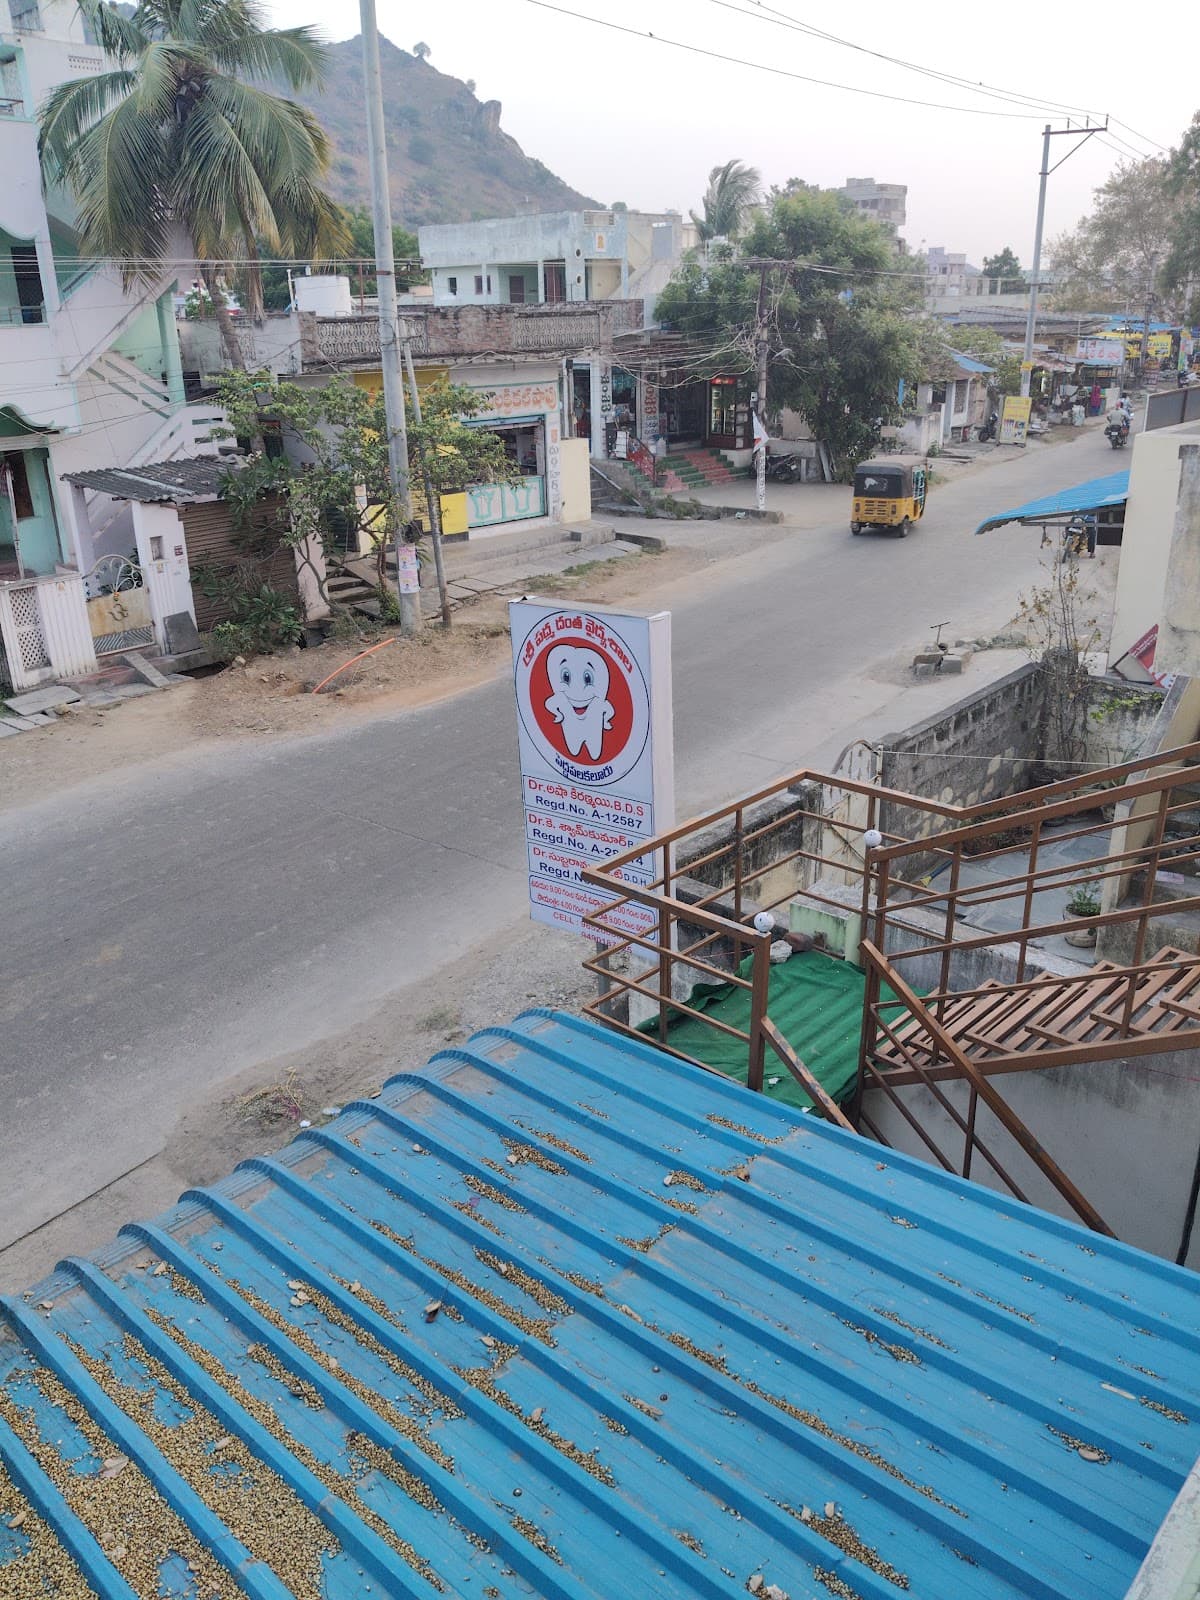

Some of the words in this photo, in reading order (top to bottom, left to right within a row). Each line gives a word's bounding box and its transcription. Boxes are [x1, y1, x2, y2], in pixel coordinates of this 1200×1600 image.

[523, 640, 535, 667] శ్రీ
[535, 622, 555, 646] పద్మ
[555, 616, 583, 631] దంత
[535, 795, 588, 816] Regd.No.
[592, 809, 642, 829] A-12587
[532, 828, 587, 850] Regd.No.
